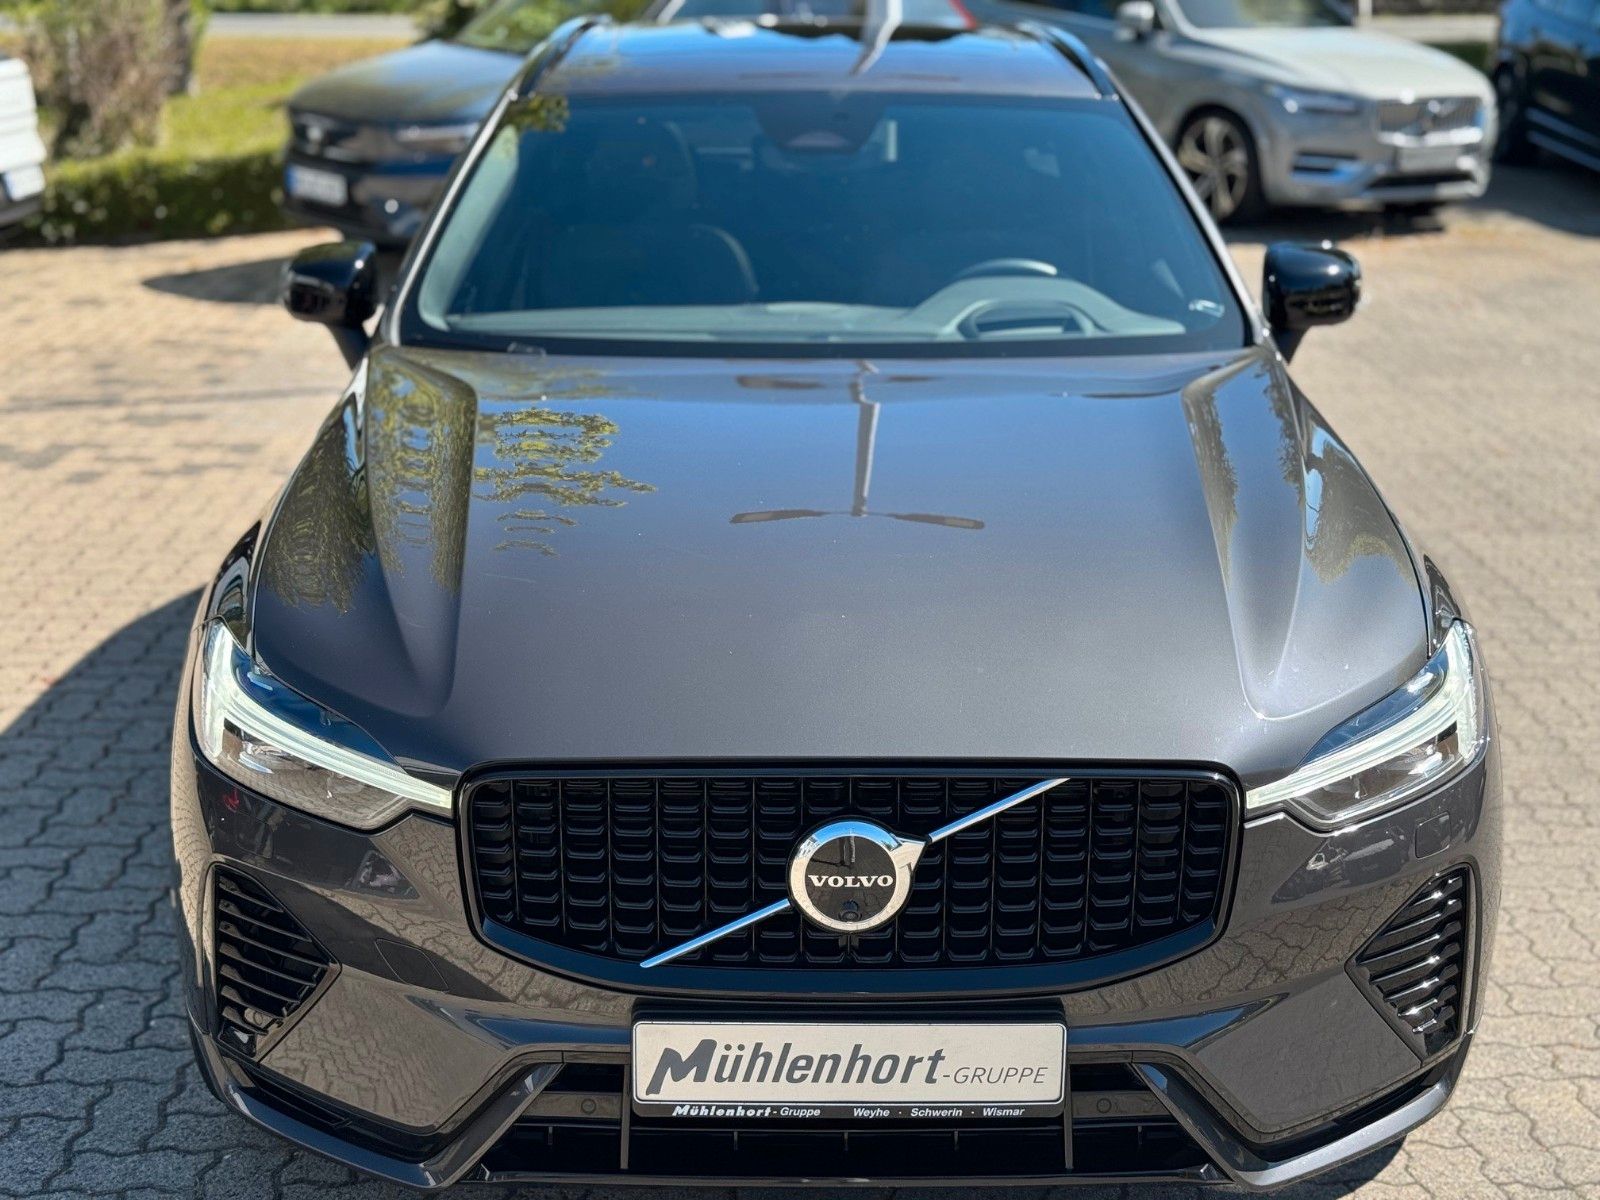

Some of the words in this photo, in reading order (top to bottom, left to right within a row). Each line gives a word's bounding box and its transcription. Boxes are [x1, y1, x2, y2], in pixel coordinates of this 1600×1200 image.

[808, 875, 893, 887] VOLVO
[853, 1107, 890, 1118] Weyhe
[910, 1107, 963, 1117] Schwerin
[982, 1107, 1025, 1117] Wismar
